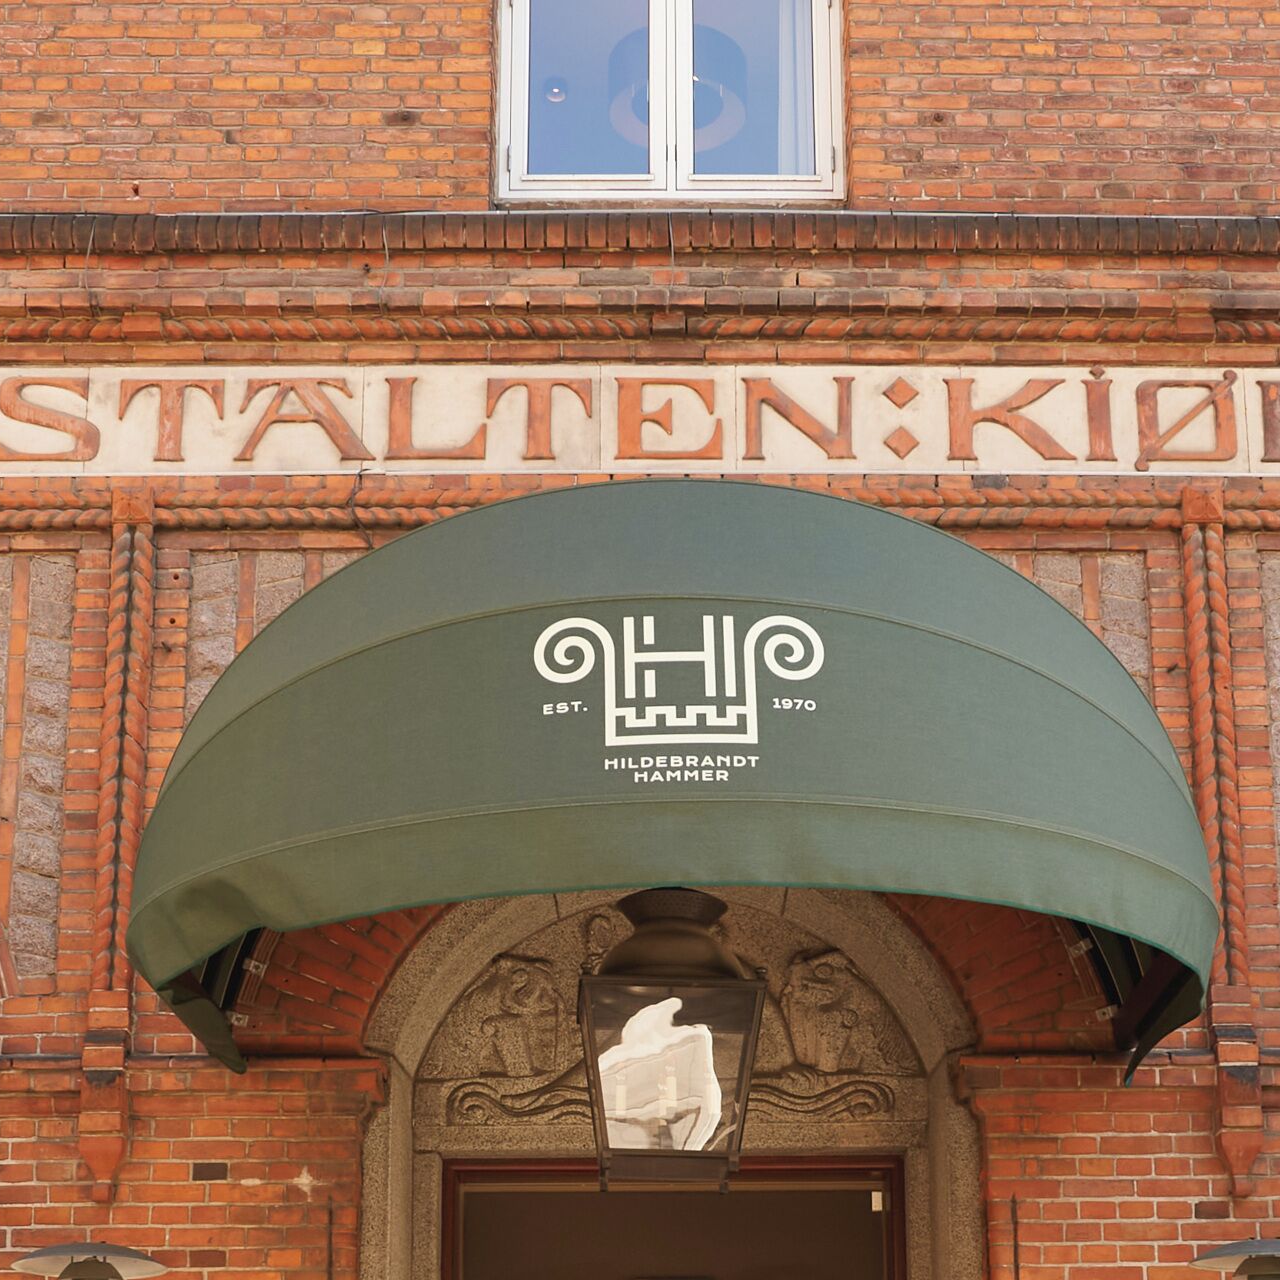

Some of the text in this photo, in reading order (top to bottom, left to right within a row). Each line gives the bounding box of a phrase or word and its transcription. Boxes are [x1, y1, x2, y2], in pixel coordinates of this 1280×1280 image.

[542, 701, 589, 715] EST.
[772, 697, 817, 711] 1970
[604, 755, 760, 770] HILDEBRANDT
[633, 769, 730, 783] HAMMER
